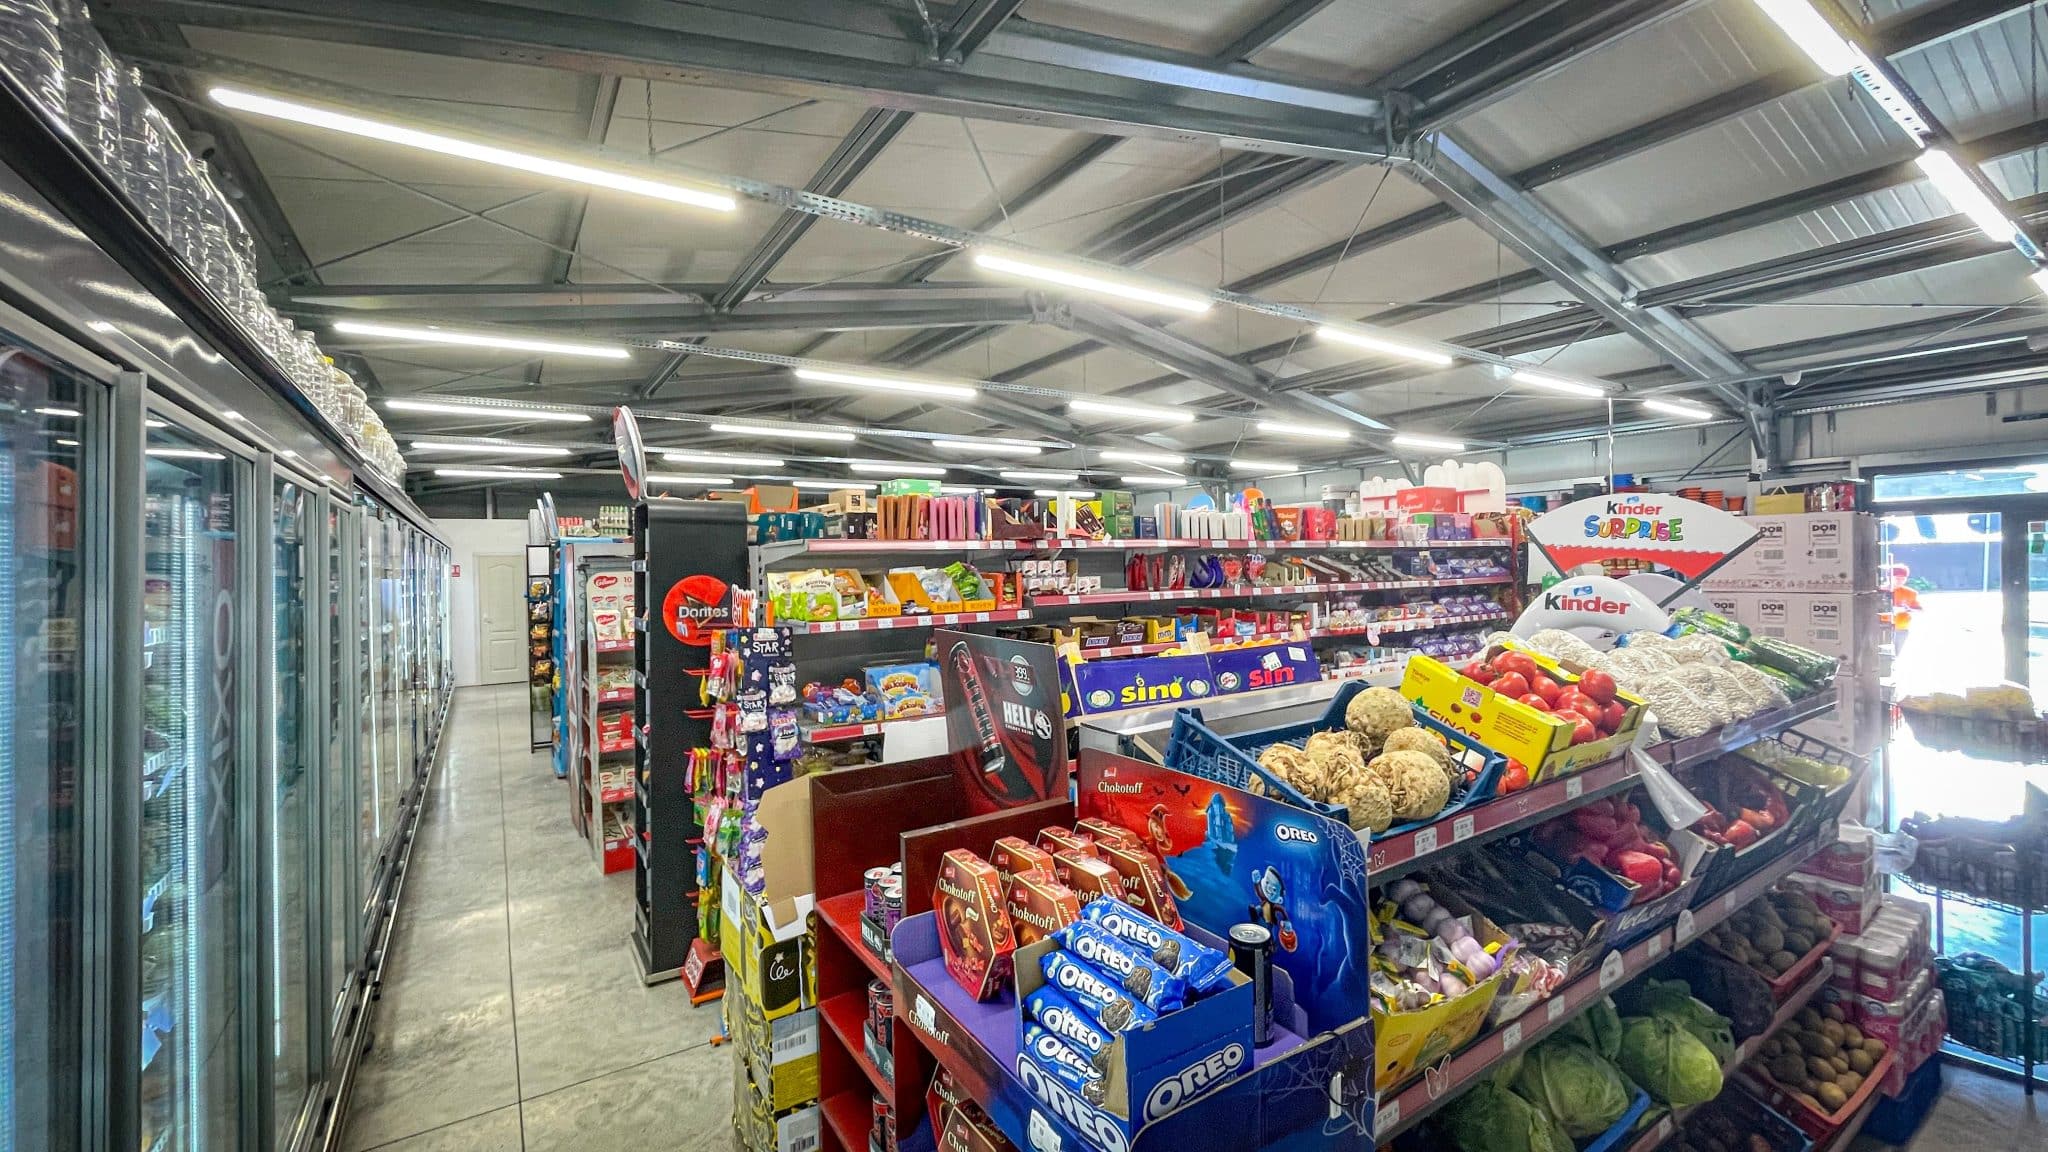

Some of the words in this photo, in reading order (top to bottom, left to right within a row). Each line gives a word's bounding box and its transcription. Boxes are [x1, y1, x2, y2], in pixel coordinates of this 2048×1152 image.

[1606, 501, 1663, 515] Kinder
[1584, 514, 1684, 541] SURPRISE
[678, 605, 729, 618] Doritos
[1544, 593, 1631, 615] Kinder
[753, 641, 780, 654] STAR
[1003, 700, 1034, 731] HELL
[1098, 781, 1143, 794] Chokotoff
[1276, 824, 1318, 843] OREO
[939, 878, 976, 903] Chokotoff
[1007, 901, 1056, 930] Chokotoff
[1101, 915, 1162, 949] OREO
[1076, 936, 1134, 976] OREO
[1058, 964, 1117, 1004] OREO
[1043, 1006, 1102, 1052] OREO
[1146, 1043, 1244, 1119] OREO
[1019, 1056, 1129, 1152] OREO
